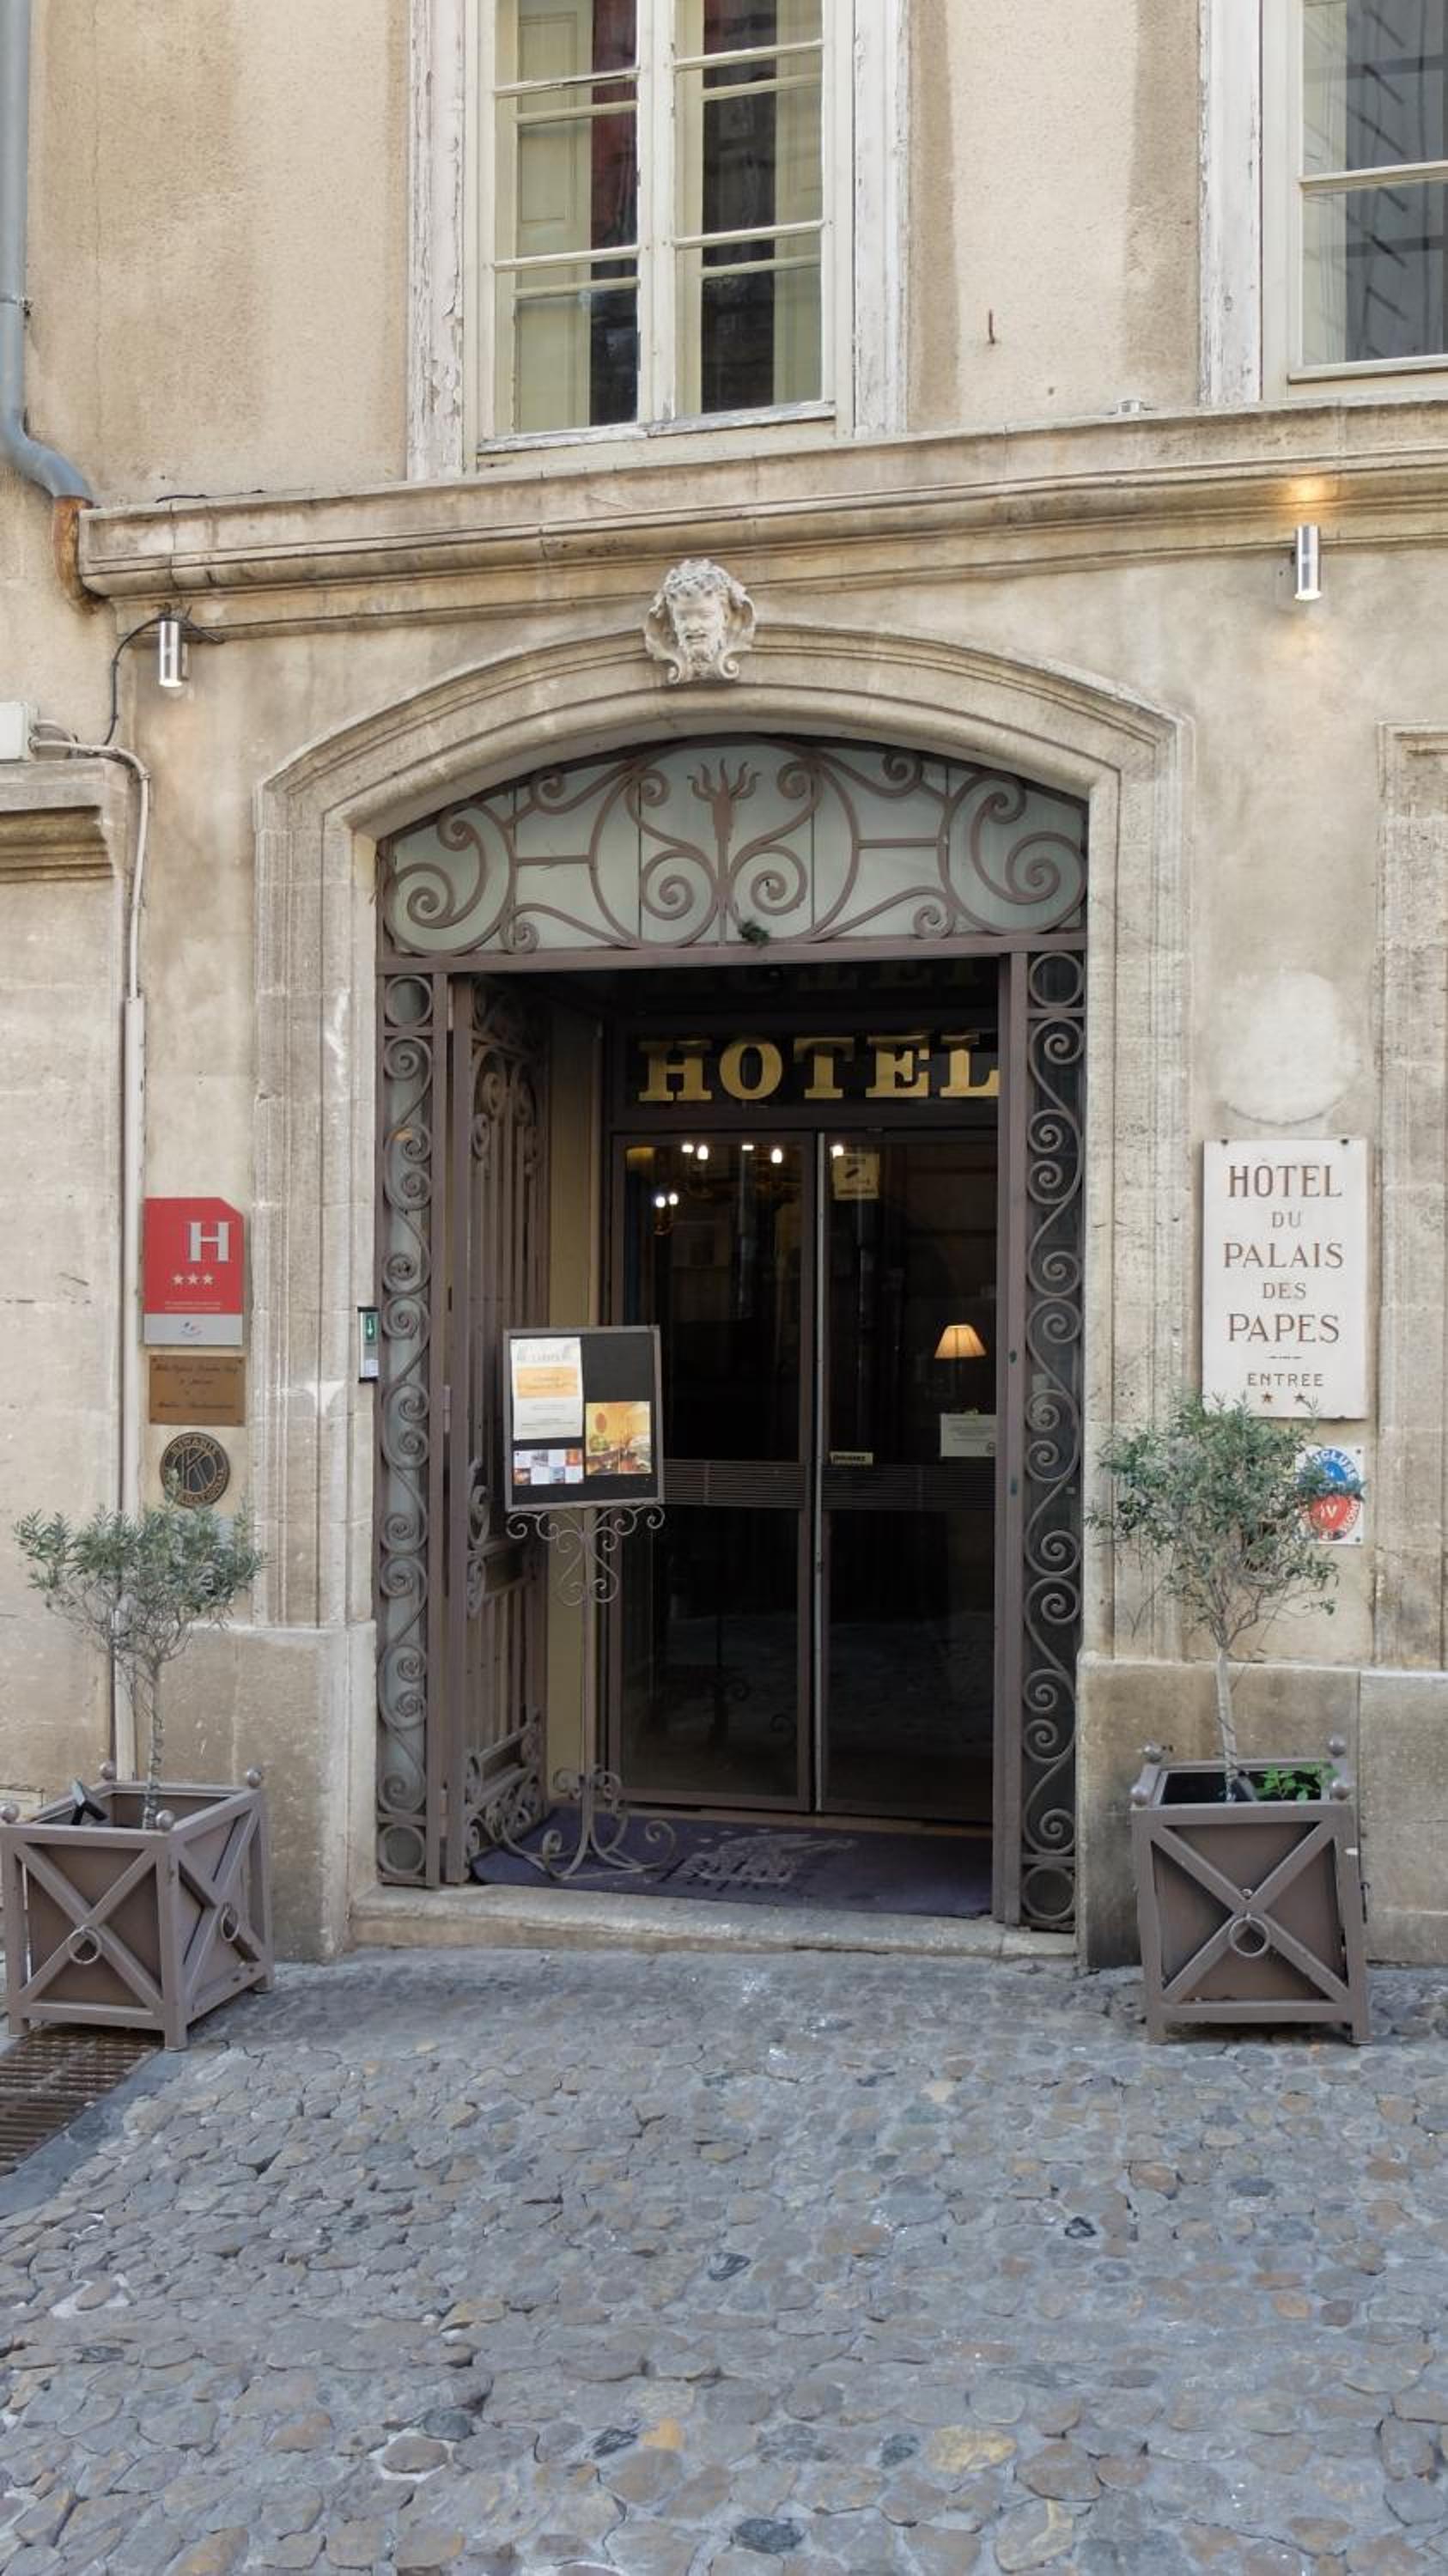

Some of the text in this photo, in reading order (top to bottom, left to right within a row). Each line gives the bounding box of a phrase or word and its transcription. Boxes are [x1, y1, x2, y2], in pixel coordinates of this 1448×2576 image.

[638, 1032, 1001, 1102] HOTEL
[1271, 1210, 1302, 1229] DU
[189, 1221, 230, 1262] H
[1223, 1242, 1343, 1269] PALAIS
[1262, 1282, 1307, 1301] DES
[1227, 1313, 1340, 1344] PAPES
